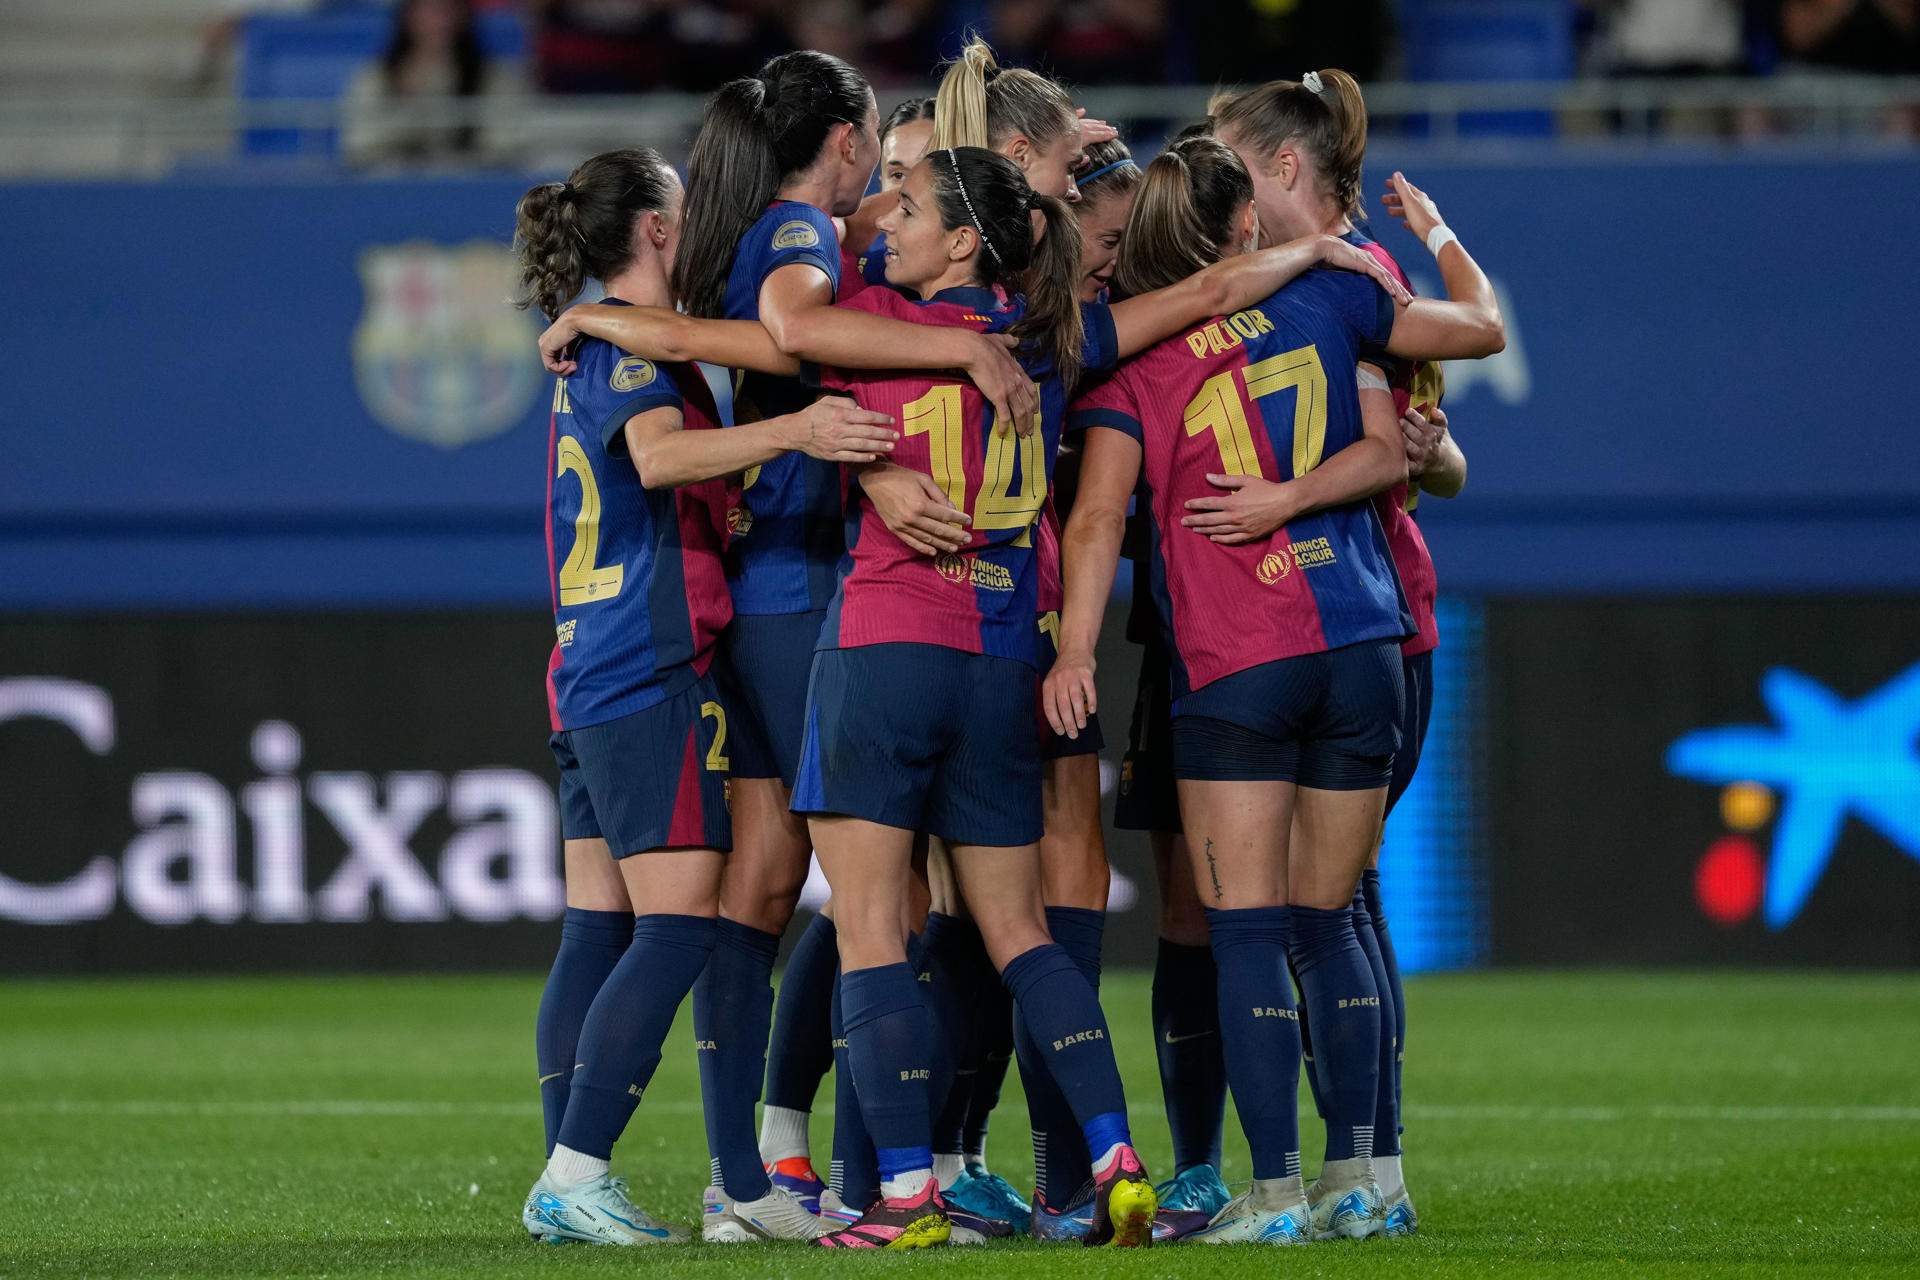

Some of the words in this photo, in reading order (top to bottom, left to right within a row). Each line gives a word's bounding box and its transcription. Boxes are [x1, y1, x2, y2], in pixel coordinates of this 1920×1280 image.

[1186, 309, 1275, 359] PAJOR
[1183, 344, 1328, 494] 17
[902, 382, 1048, 548] 14
[557, 434, 624, 606] 2
[970, 557, 1010, 578] UNHCR
[1287, 537, 1330, 555] UNHCR
[1295, 548, 1335, 566] ACNUR
[969, 570, 1014, 587] ACNUR
[701, 701, 730, 771] 2
